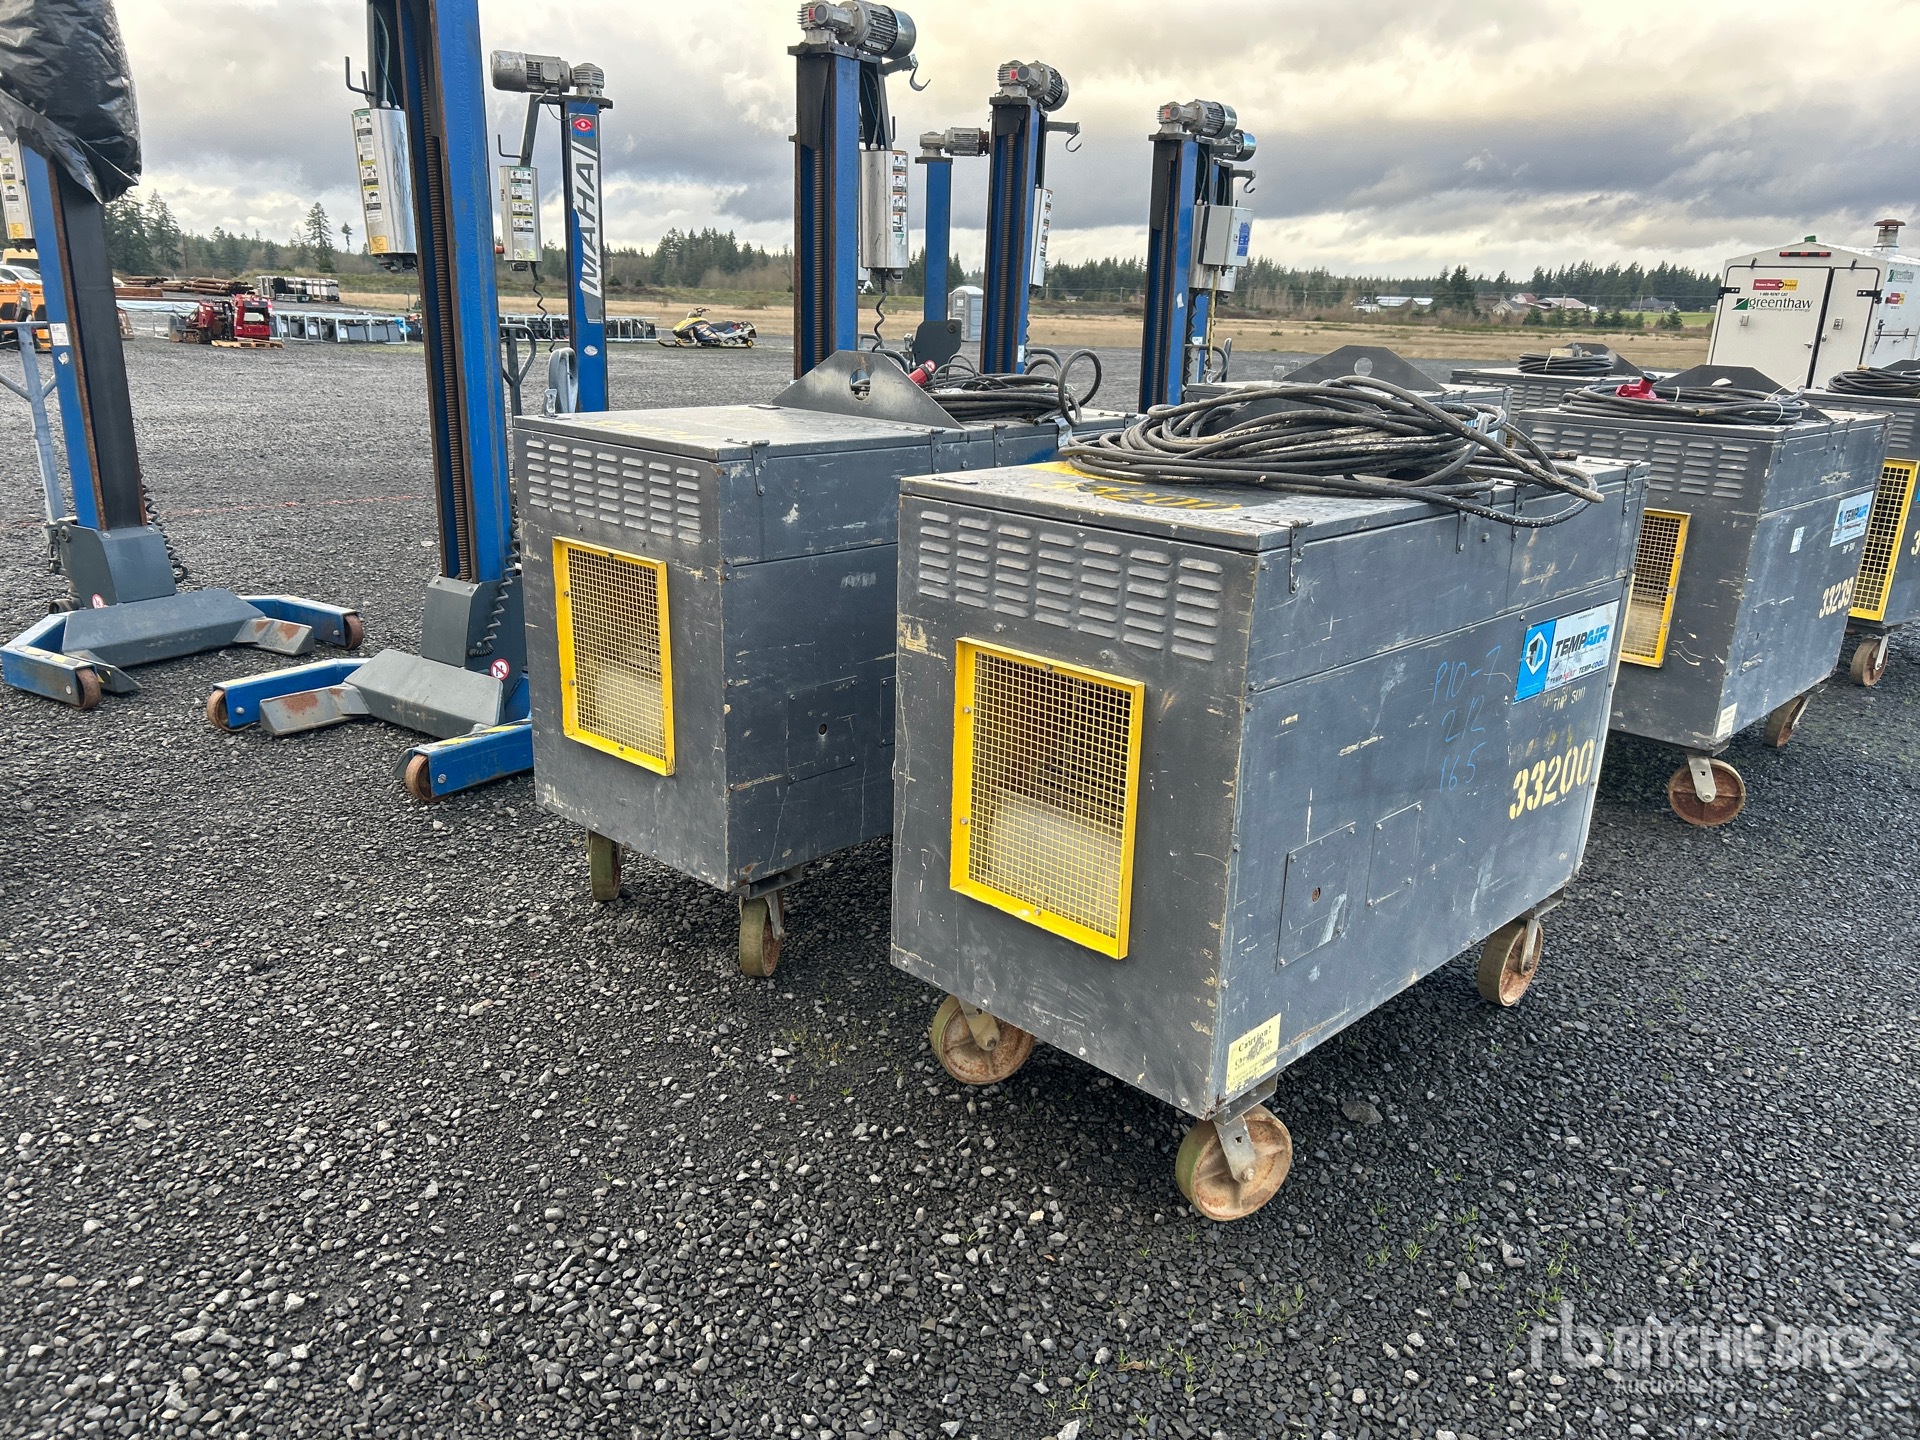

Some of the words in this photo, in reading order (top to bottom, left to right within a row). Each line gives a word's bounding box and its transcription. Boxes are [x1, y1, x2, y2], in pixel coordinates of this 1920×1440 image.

[576, 162, 598, 291] MAHA
[1748, 297, 1814, 310] greenthaw
[1818, 576, 1855, 619] 33239
[1554, 624, 1611, 659] TEMPAIR
[1439, 741, 1487, 794] 165
[1509, 738, 1595, 820] 33200
